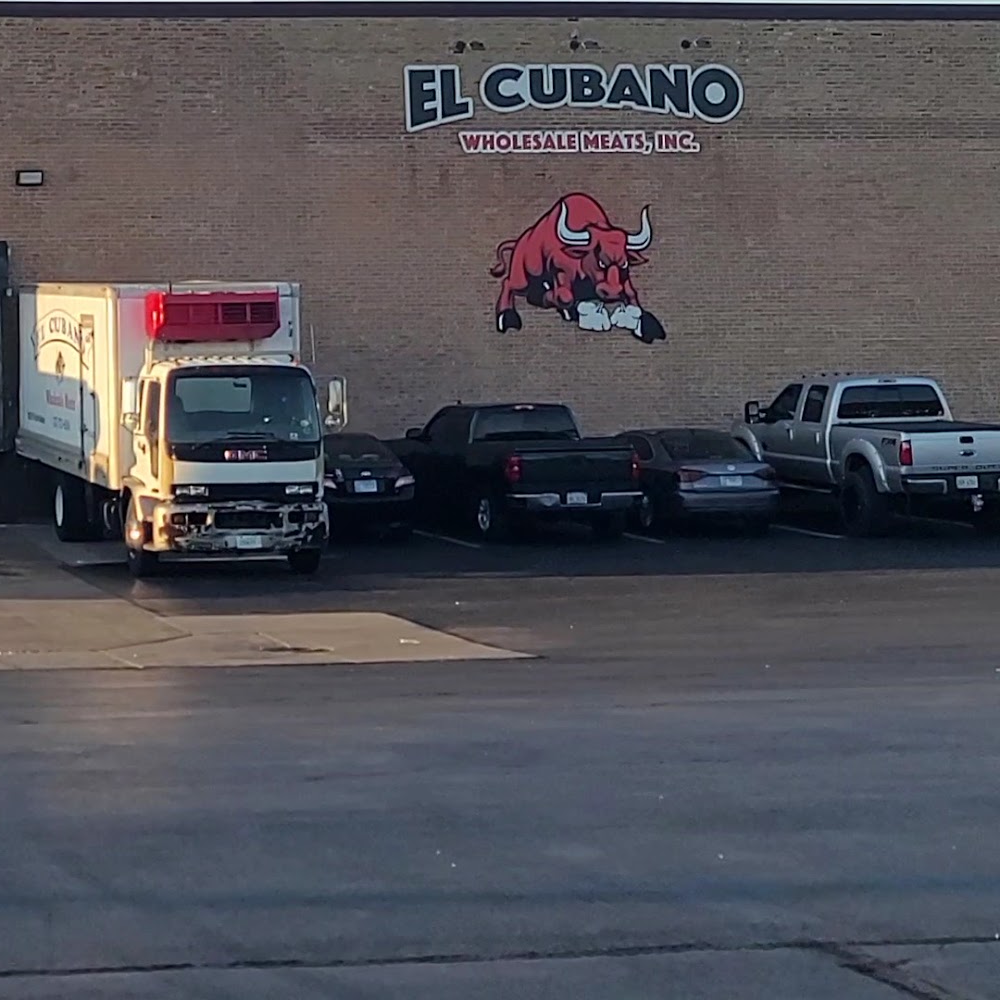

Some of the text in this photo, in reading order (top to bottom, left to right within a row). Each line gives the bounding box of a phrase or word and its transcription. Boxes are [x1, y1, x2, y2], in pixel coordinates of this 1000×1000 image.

[405, 64, 743, 131] EL CUBANO
[460, 132, 699, 154] WHOLESALE MEATS, INC.
[224, 450, 268, 460] GMC
